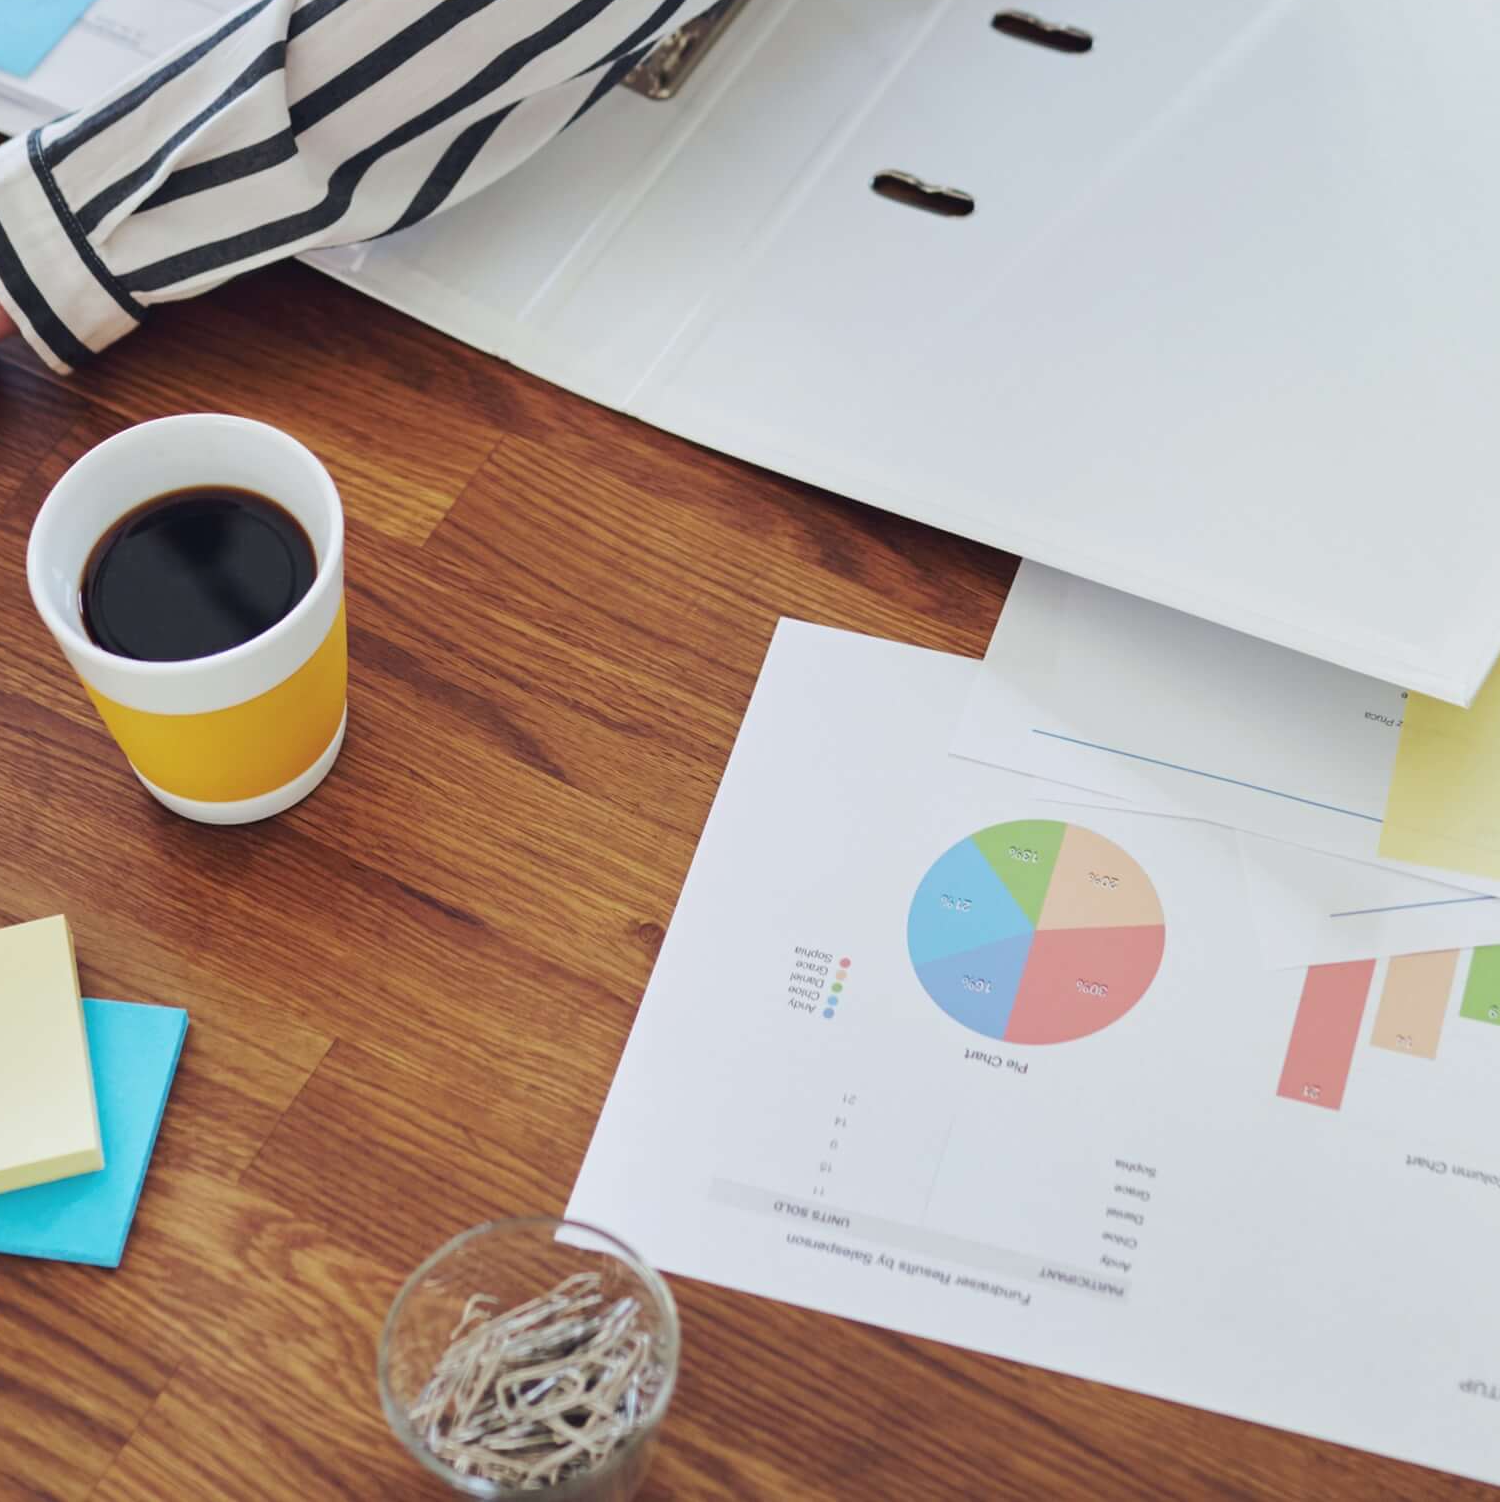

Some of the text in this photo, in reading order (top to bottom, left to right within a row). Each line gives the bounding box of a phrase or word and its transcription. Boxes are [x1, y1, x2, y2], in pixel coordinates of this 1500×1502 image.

[795, 946, 833, 963] Sophia
[796, 961, 829, 976] Grace
[790, 972, 825, 989] Daniel
[961, 977, 991, 994] 16%
[1076, 979, 1108, 997] 30%
[788, 986, 820, 1001] Chloe
[788, 998, 817, 1014] Andy
[964, 1050, 1029, 1074] Pie Chart
[1116, 1160, 1157, 1178] Sophia
[1406, 1155, 1448, 1174] Chart
[1114, 1185, 1151, 1202] Grace
[1106, 1208, 1144, 1226] Daniel
[774, 1202, 1124, 1297] PARTICIPANT UNITS SOLD
[1102, 1232, 1138, 1250] Chloe
[787, 1234, 1032, 1306] Fundraiser Results by Salesperson
[1100, 1255, 1132, 1273] Andy
